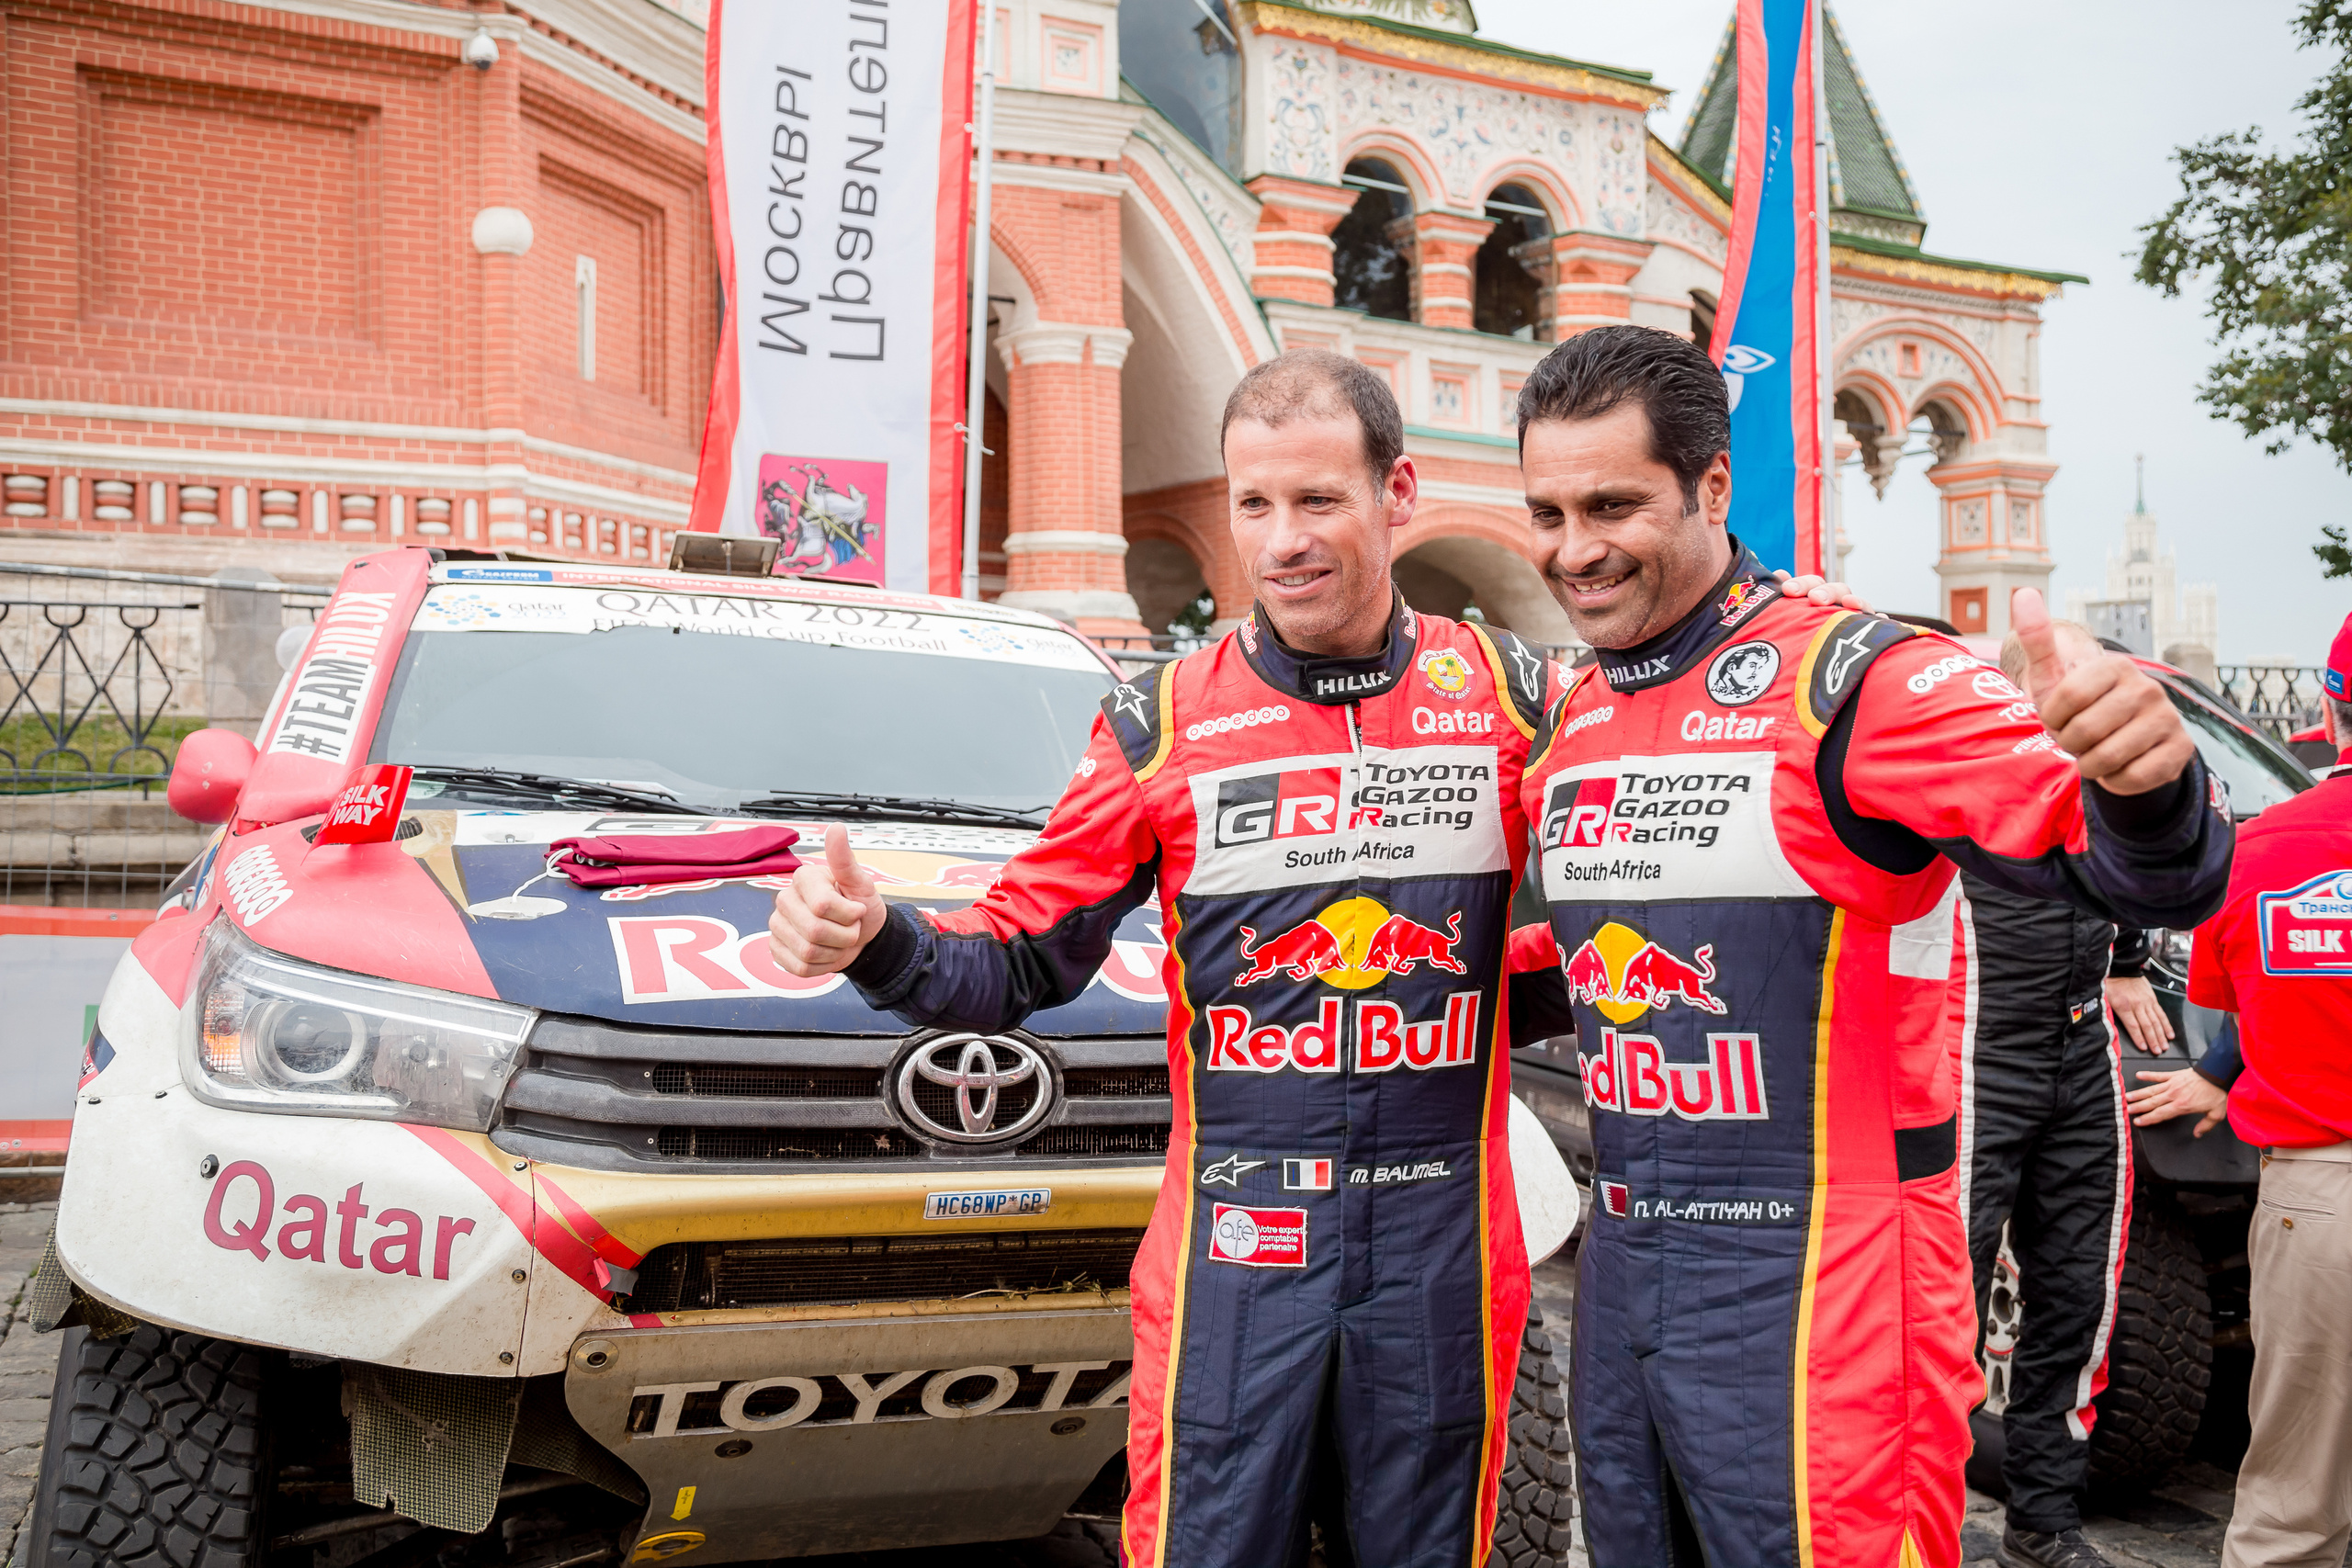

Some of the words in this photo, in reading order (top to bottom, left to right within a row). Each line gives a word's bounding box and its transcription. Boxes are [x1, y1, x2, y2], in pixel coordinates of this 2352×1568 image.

[562, 571, 728, 588] INTERNATIONAL
[730, 582, 775, 592] SILK
[777, 586, 822, 595] WAY
[826, 590, 884, 602] RALLY
[596, 592, 782, 619] QATAR
[799, 603, 931, 632] 2022
[1721, 604, 1751, 626] Red
[1747, 585, 1775, 607] Bull
[766, 626, 826, 644] Cup
[837, 631, 948, 651] Football
[1317, 670, 1392, 695] HILUX
[1425, 682, 1447, 697] State
[1454, 686, 1472, 700] Qatar
[1187, 705, 1290, 740] ooredoo
[1412, 705, 1494, 735] Qatar
[1680, 710, 1775, 741] Qatar
[1365, 762, 1489, 784] TOYOTA
[1621, 773, 1750, 795] TOYOTA
[340, 784, 390, 807] SILK
[1360, 785, 1477, 806] GAZOO
[1613, 797, 1730, 818] GAZOO
[332, 804, 383, 826] WAY
[1219, 795, 1336, 844] GR
[1359, 806, 1474, 831] Racing
[1544, 805, 1608, 851] GR
[1611, 820, 1719, 847] Racing
[1284, 847, 1347, 868] South
[1358, 840, 1415, 860] Africa
[1564, 861, 1608, 881] South
[1608, 859, 1661, 881] Africa
[2288, 929, 2345, 953] SILK
[1206, 997, 1341, 1073] Red
[1354, 991, 1481, 1073] Bull
[1578, 1027, 1622, 1111] ed
[1620, 1034, 1769, 1120] Bull
[1373, 1161, 1451, 1183] BAUMEL
[936, 1195, 1007, 1215] HC68WP
[1019, 1193, 1041, 1212] GP
[1655, 1200, 1762, 1220] AL-ATTIYAH
[203, 1160, 476, 1281] Qatar
[1258, 1224, 1277, 1234] Votre
[1279, 1225, 1304, 1236] expert
[1260, 1235, 1298, 1245] comptable
[1260, 1243, 1297, 1252] partenaire
